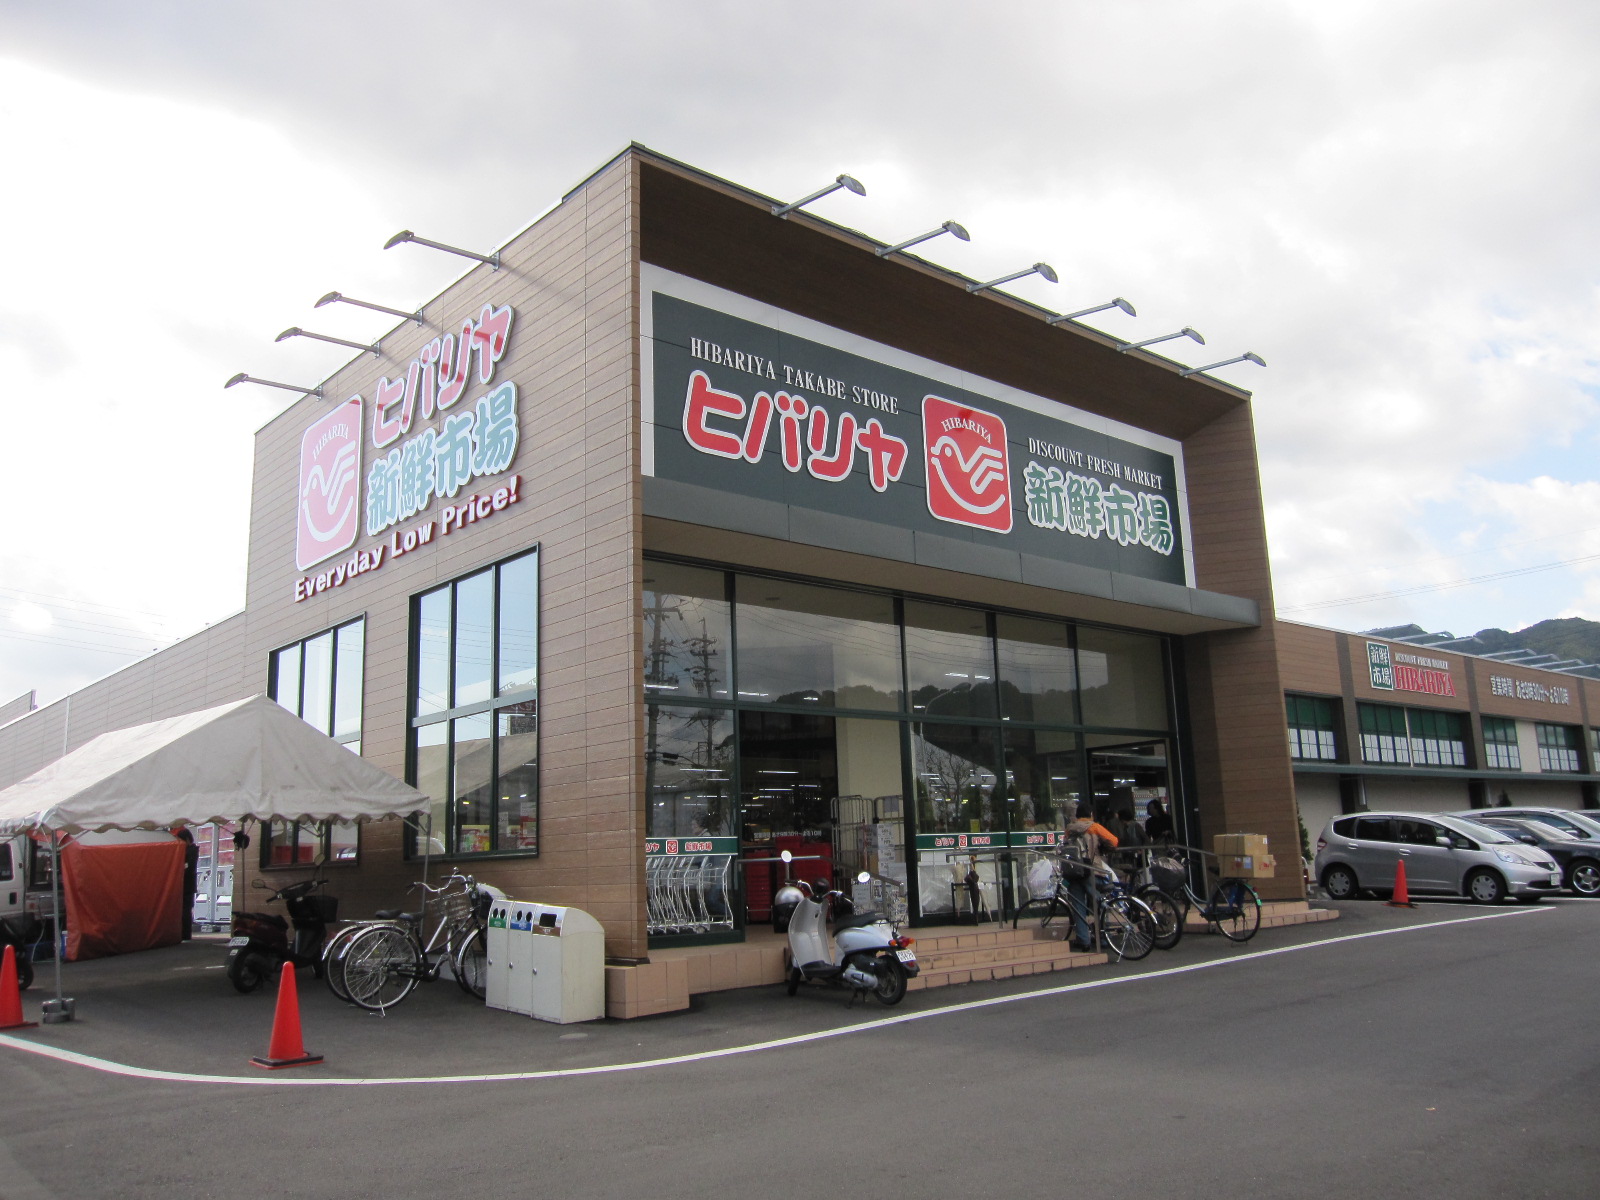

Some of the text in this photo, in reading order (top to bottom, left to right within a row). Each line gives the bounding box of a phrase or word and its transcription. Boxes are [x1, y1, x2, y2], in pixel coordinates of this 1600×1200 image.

[373, 304, 515, 448] ヒバリヤ
[690, 337, 899, 415] HIBARIYA TAKABE STORE
[312, 423, 349, 462] HIBARIYA
[366, 380, 519, 536] 新鮮市場
[683, 370, 908, 493] ヒバリヤ
[941, 417, 992, 445] HIBARIYA
[1028, 437, 1163, 491] DISCOUNT FRESH MARKET
[294, 475, 521, 603] Everyday Low Price!
[1023, 461, 1175, 556] 新鮮市場
[1393, 664, 1456, 697] HIBARIYA
